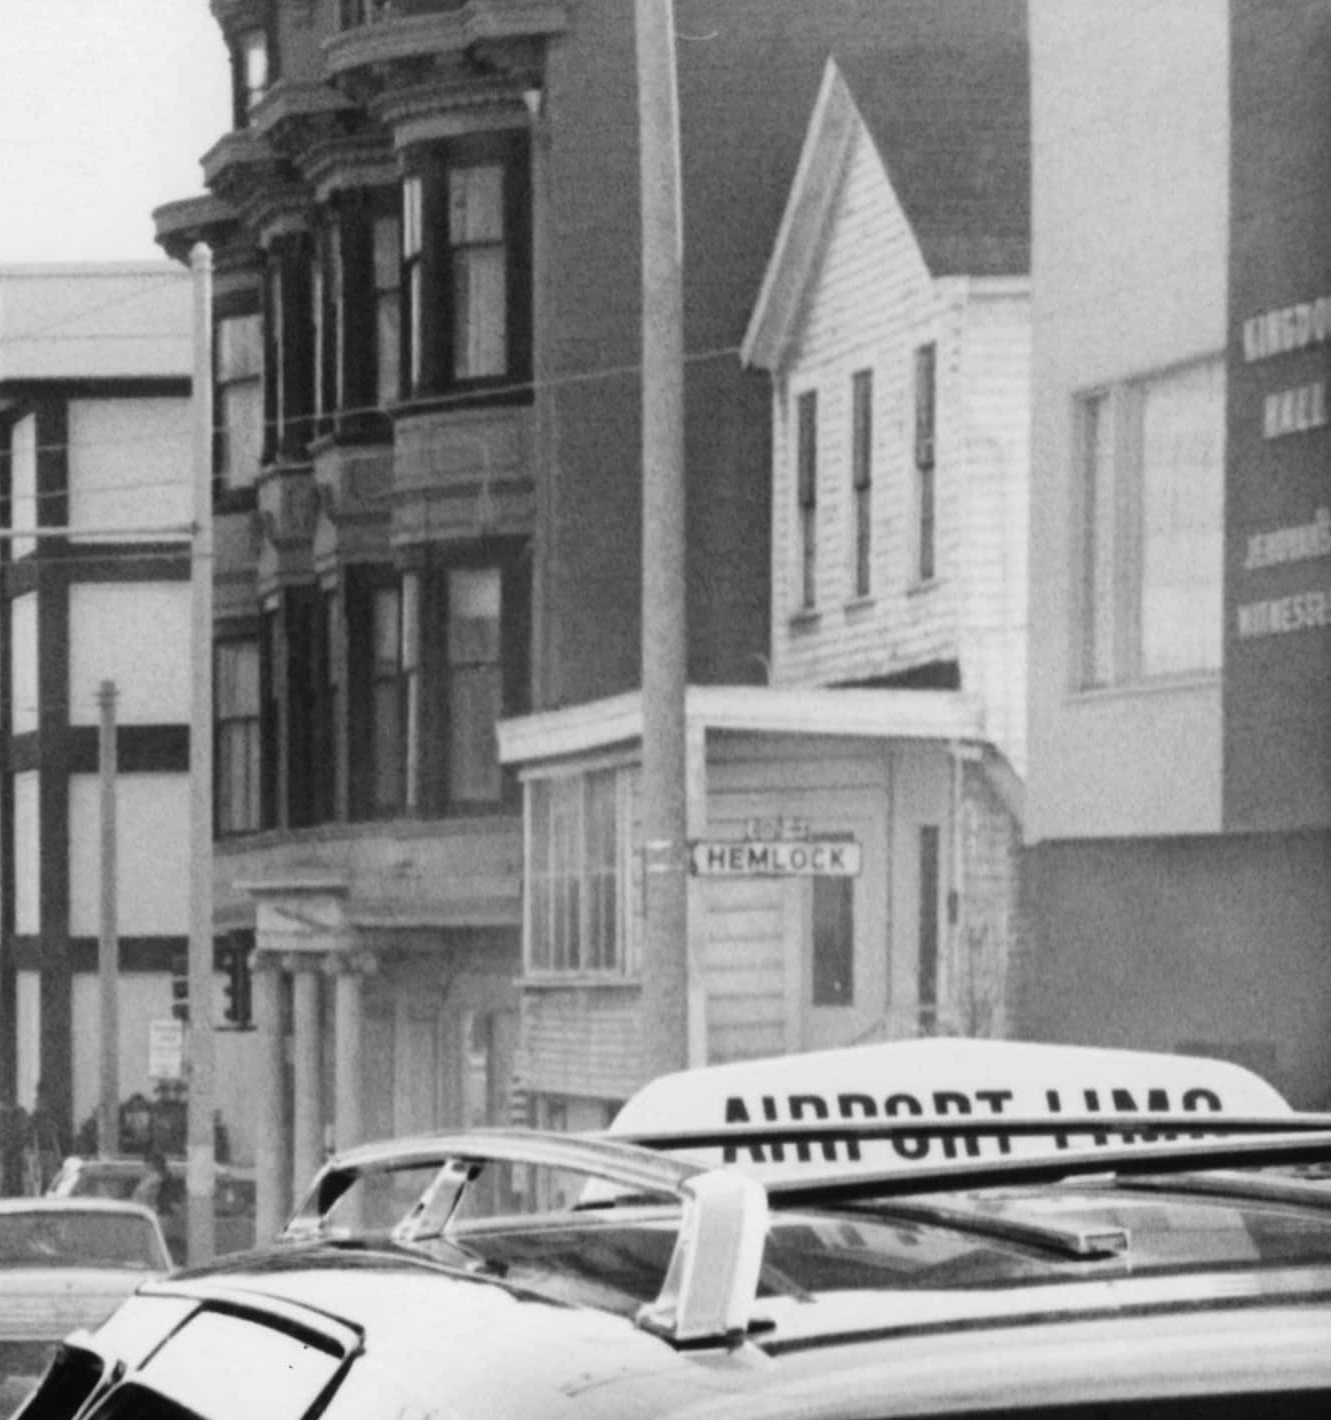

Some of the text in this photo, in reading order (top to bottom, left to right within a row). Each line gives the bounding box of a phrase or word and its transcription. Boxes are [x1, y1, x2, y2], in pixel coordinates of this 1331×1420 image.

[1264, 382, 1325, 438] HALL
[707, 847, 844, 870] HEMLOCK
[724, 1090, 1013, 1163] AIRPORT
